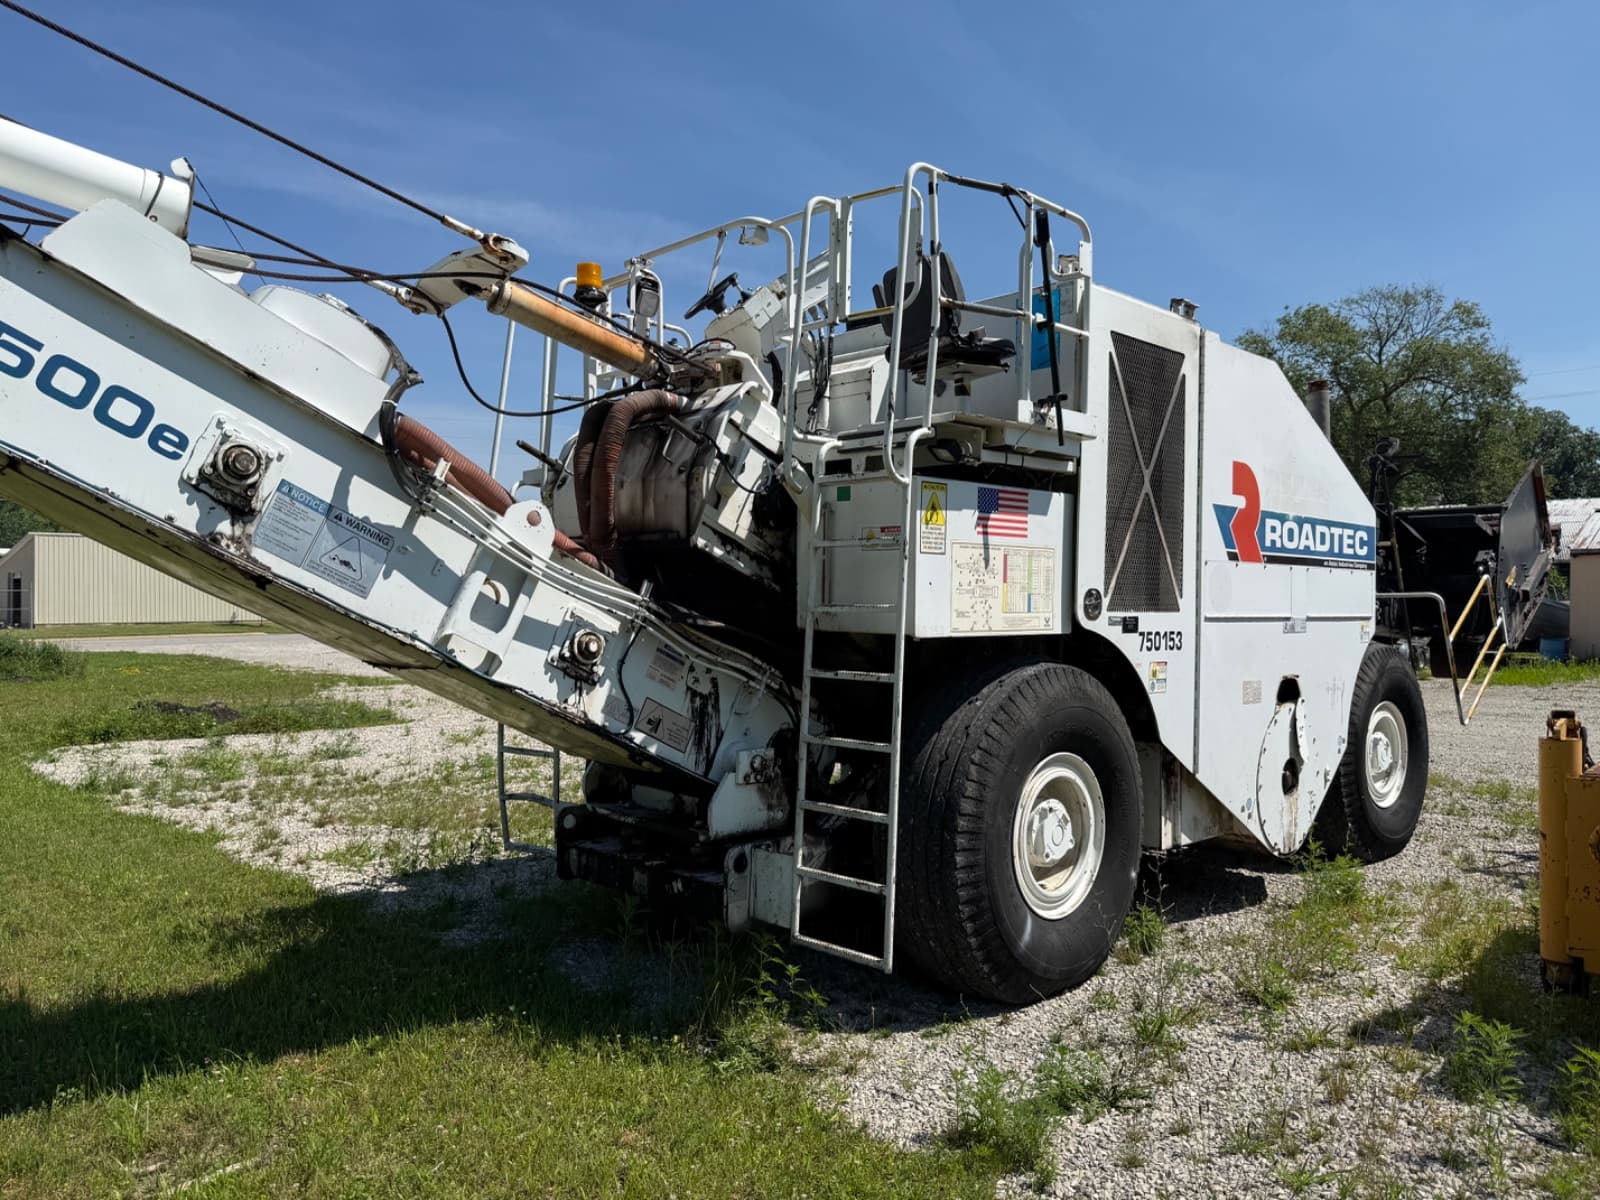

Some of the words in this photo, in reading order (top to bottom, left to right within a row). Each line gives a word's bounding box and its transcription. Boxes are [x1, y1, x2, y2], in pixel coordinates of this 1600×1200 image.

[291, 489, 327, 513] NOTICE
[345, 516, 390, 546] WARNING
[1264, 518, 1369, 556] ROADTEC
[1138, 630, 1183, 652] 750153
